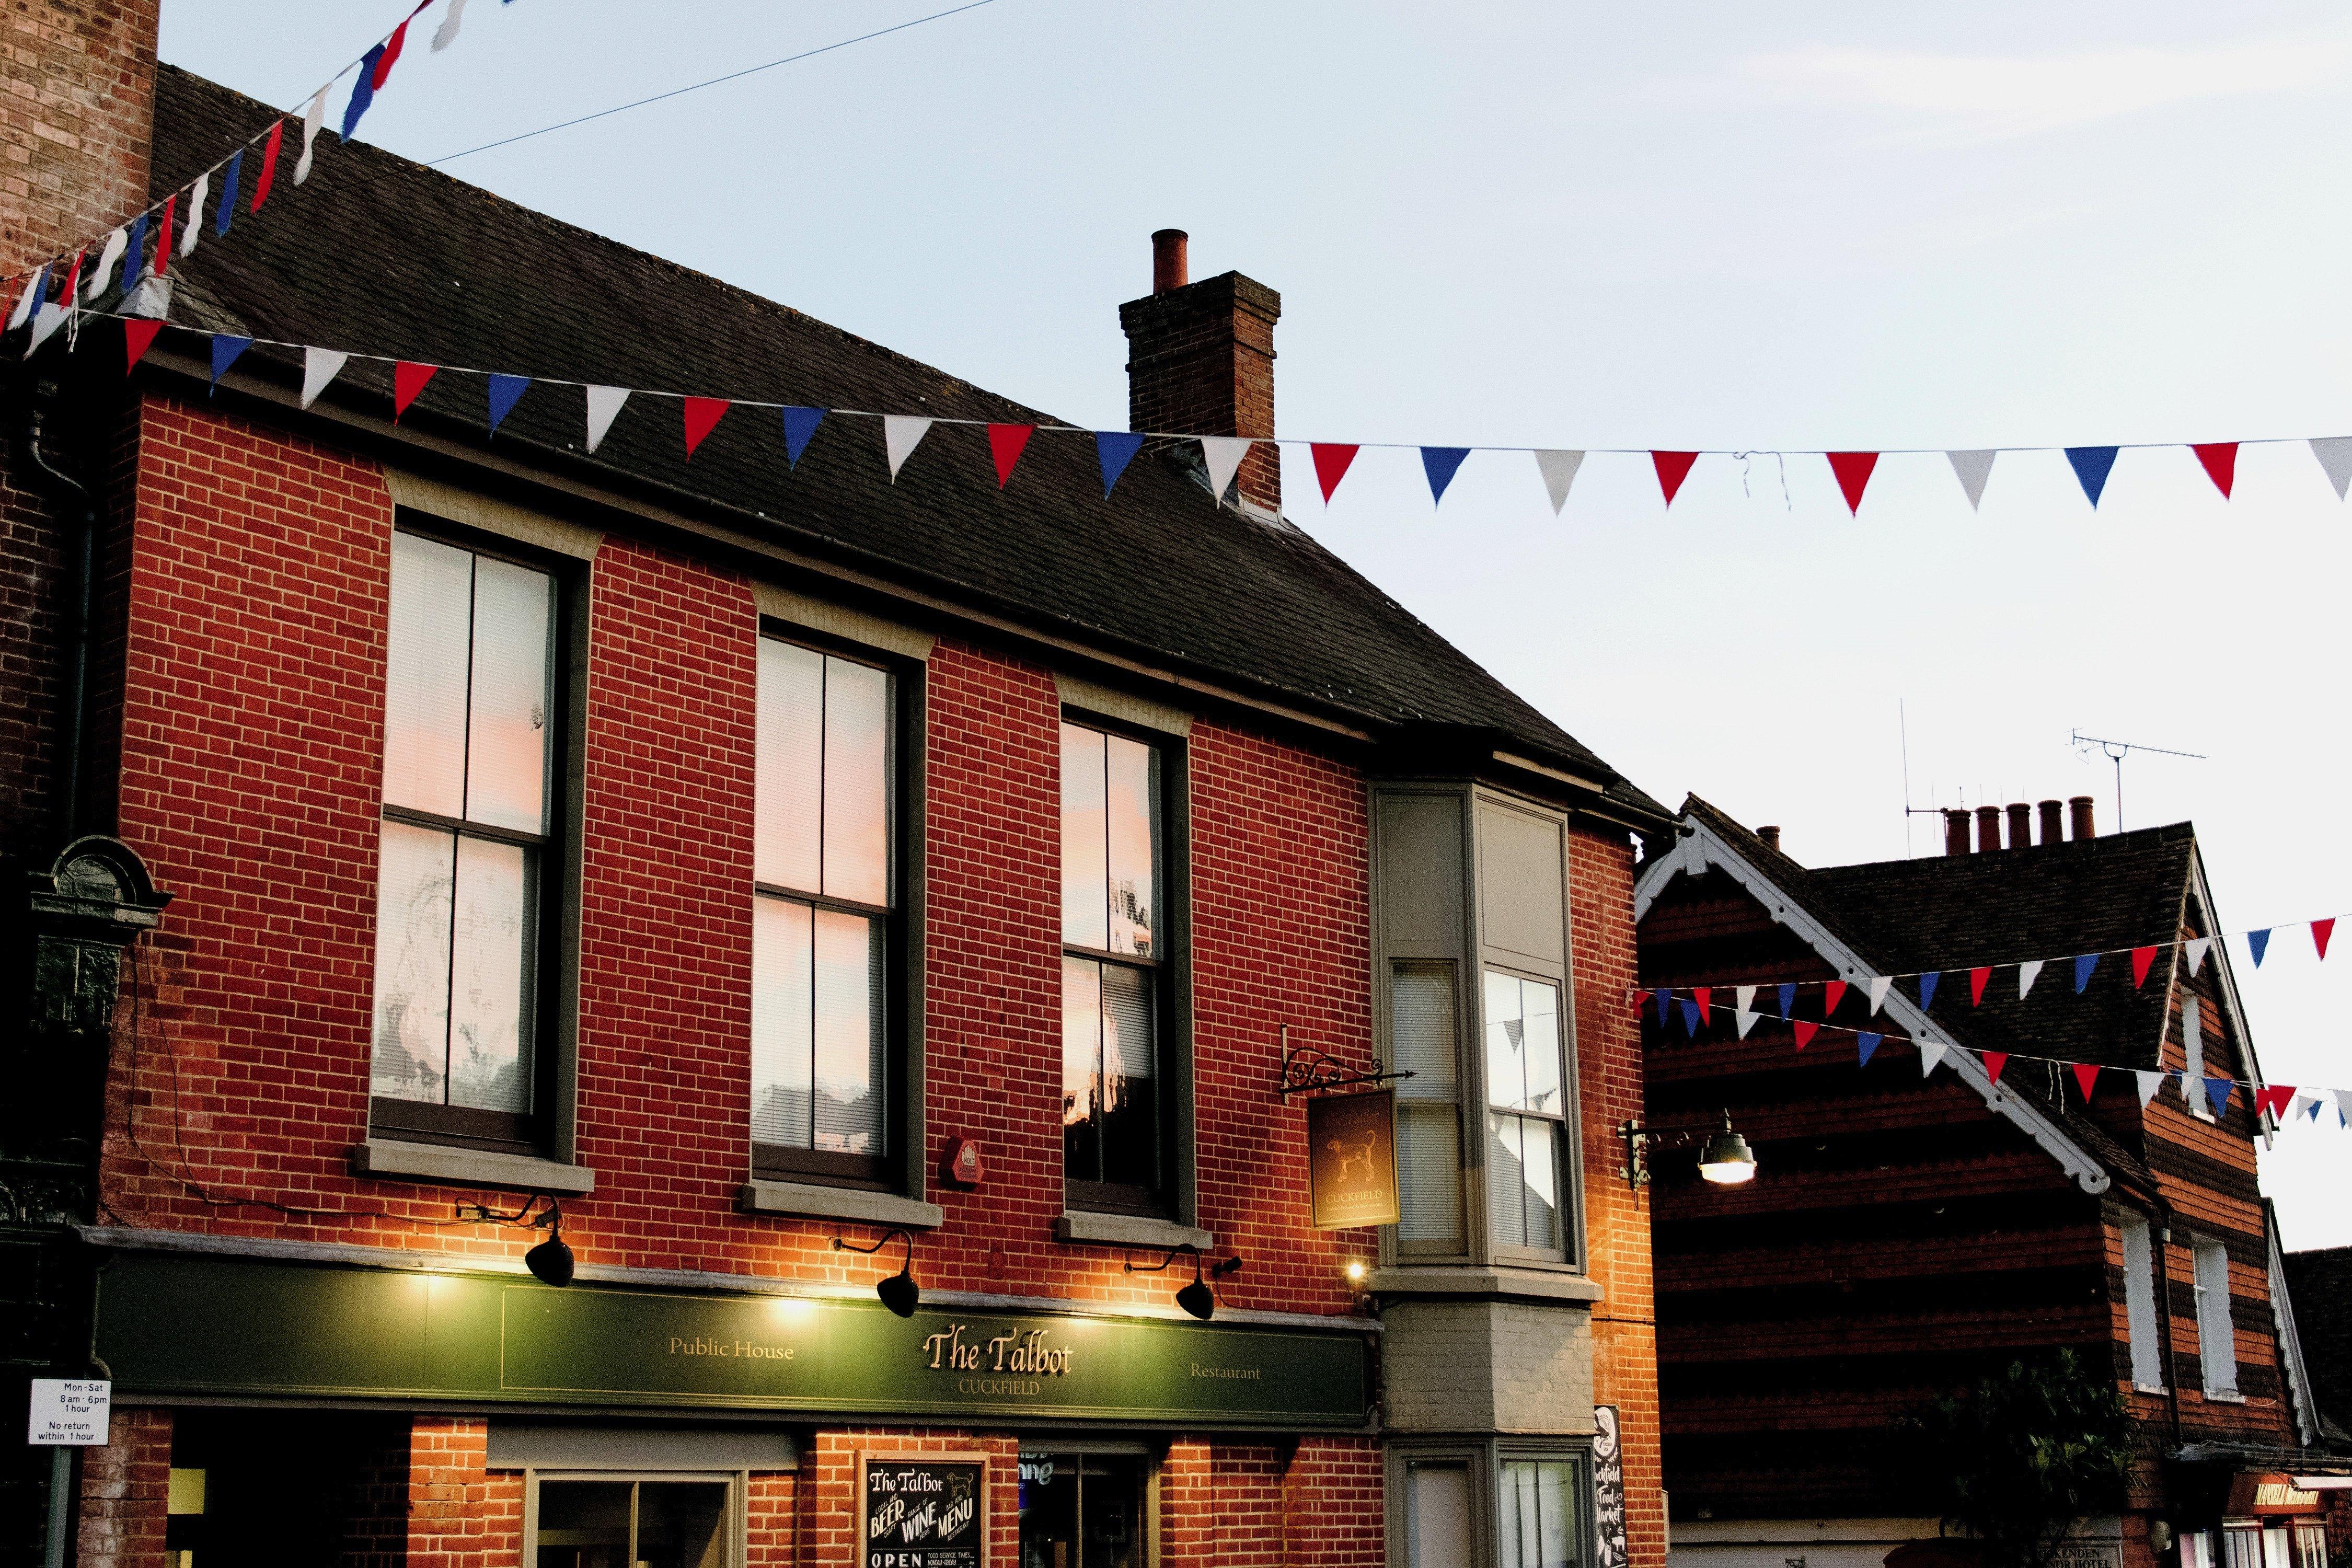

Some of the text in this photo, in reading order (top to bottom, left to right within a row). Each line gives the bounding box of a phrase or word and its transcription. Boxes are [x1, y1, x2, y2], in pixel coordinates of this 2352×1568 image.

[1325, 1190, 1383, 1204] CUCKFIELD
[670, 1337, 794, 1359] Public House
[923, 1323, 1074, 1374] The Talbot
[1191, 1363, 1261, 1379] Restaurant
[959, 1379, 1040, 1396] CUCKFIELD
[49, 1421, 61, 1429] No
[870, 1468, 943, 1492] The Talbot
[875, 1493, 898, 1515] LOCAL AND
[955, 1494, 963, 1503] AND
[1597, 1484, 1615, 1505] Food
[908, 1497, 928, 1518] RANGE OF
[938, 1497, 973, 1538] MENU
[871, 1499, 905, 1538] BEER
[902, 1501, 937, 1543] WINE
[883, 1523, 896, 1538] CRAFT
[919, 1527, 930, 1540] HERE
[947, 1520, 970, 1541] RESTAURANT
[871, 1553, 921, 1568] OPEN
[2074, 1560, 2112, 1568] HOTEL
